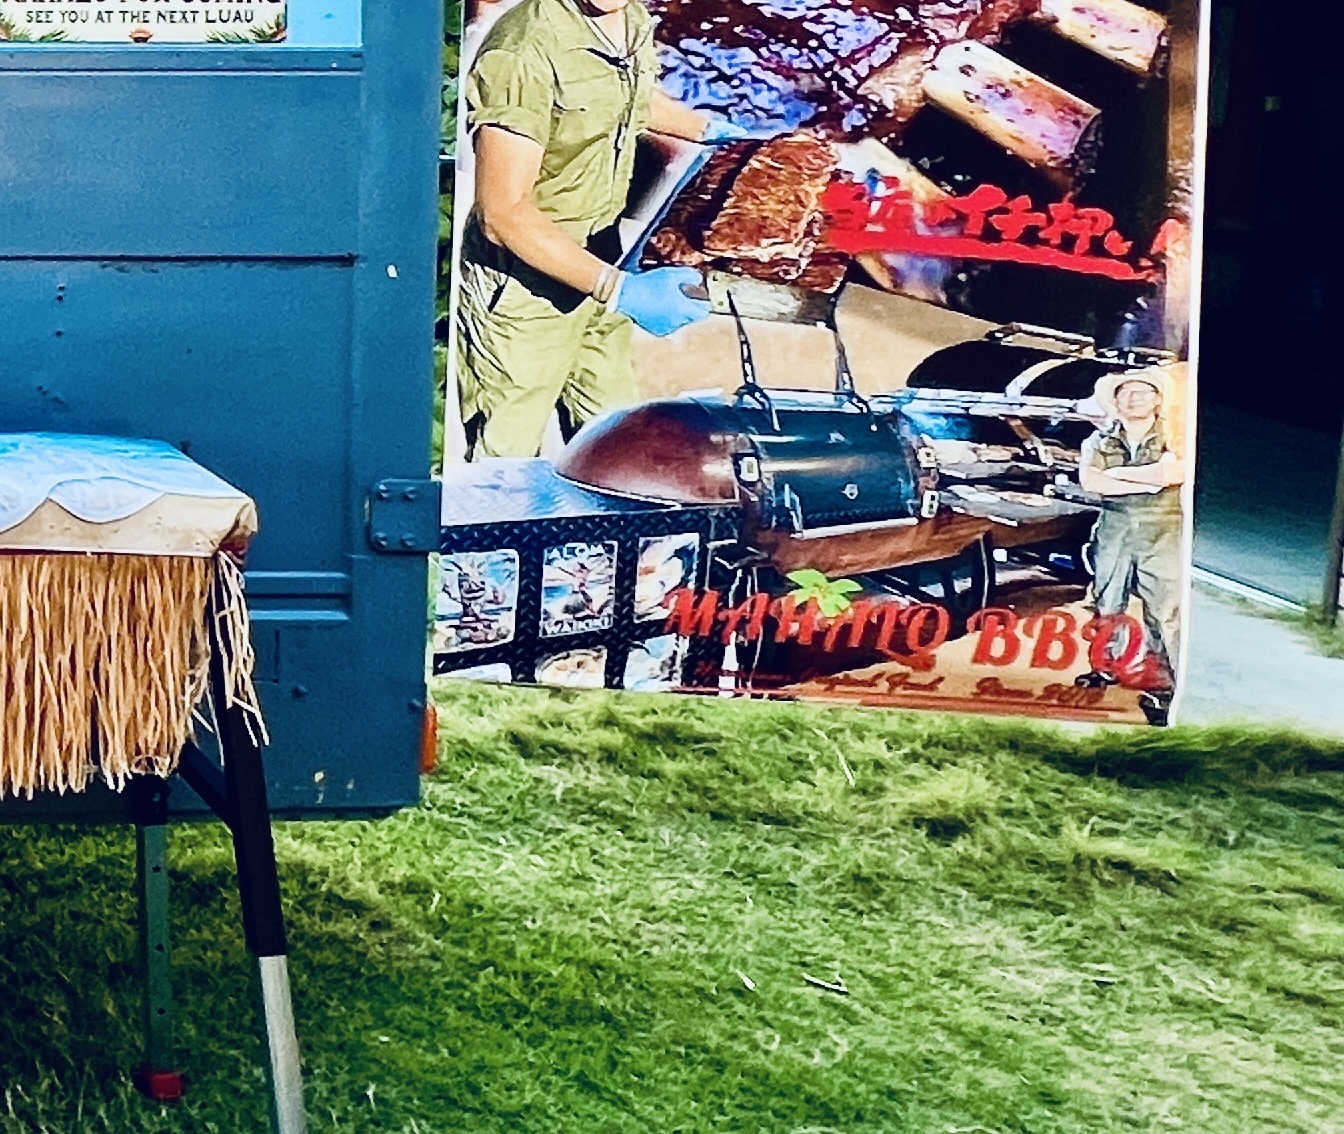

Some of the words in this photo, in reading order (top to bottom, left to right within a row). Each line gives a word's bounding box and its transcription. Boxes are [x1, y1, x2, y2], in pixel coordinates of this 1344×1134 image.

[25, 9, 54, 24] SEE
[59, 9, 90, 24] YOU
[95, 9, 113, 24] AT
[118, 9, 151, 24] THE
[156, 9, 200, 24] NEXT
[204, 9, 255, 24] LUAU
[663, 586, 950, 671] MAHALO
[966, 604, 1157, 688] BBQ
